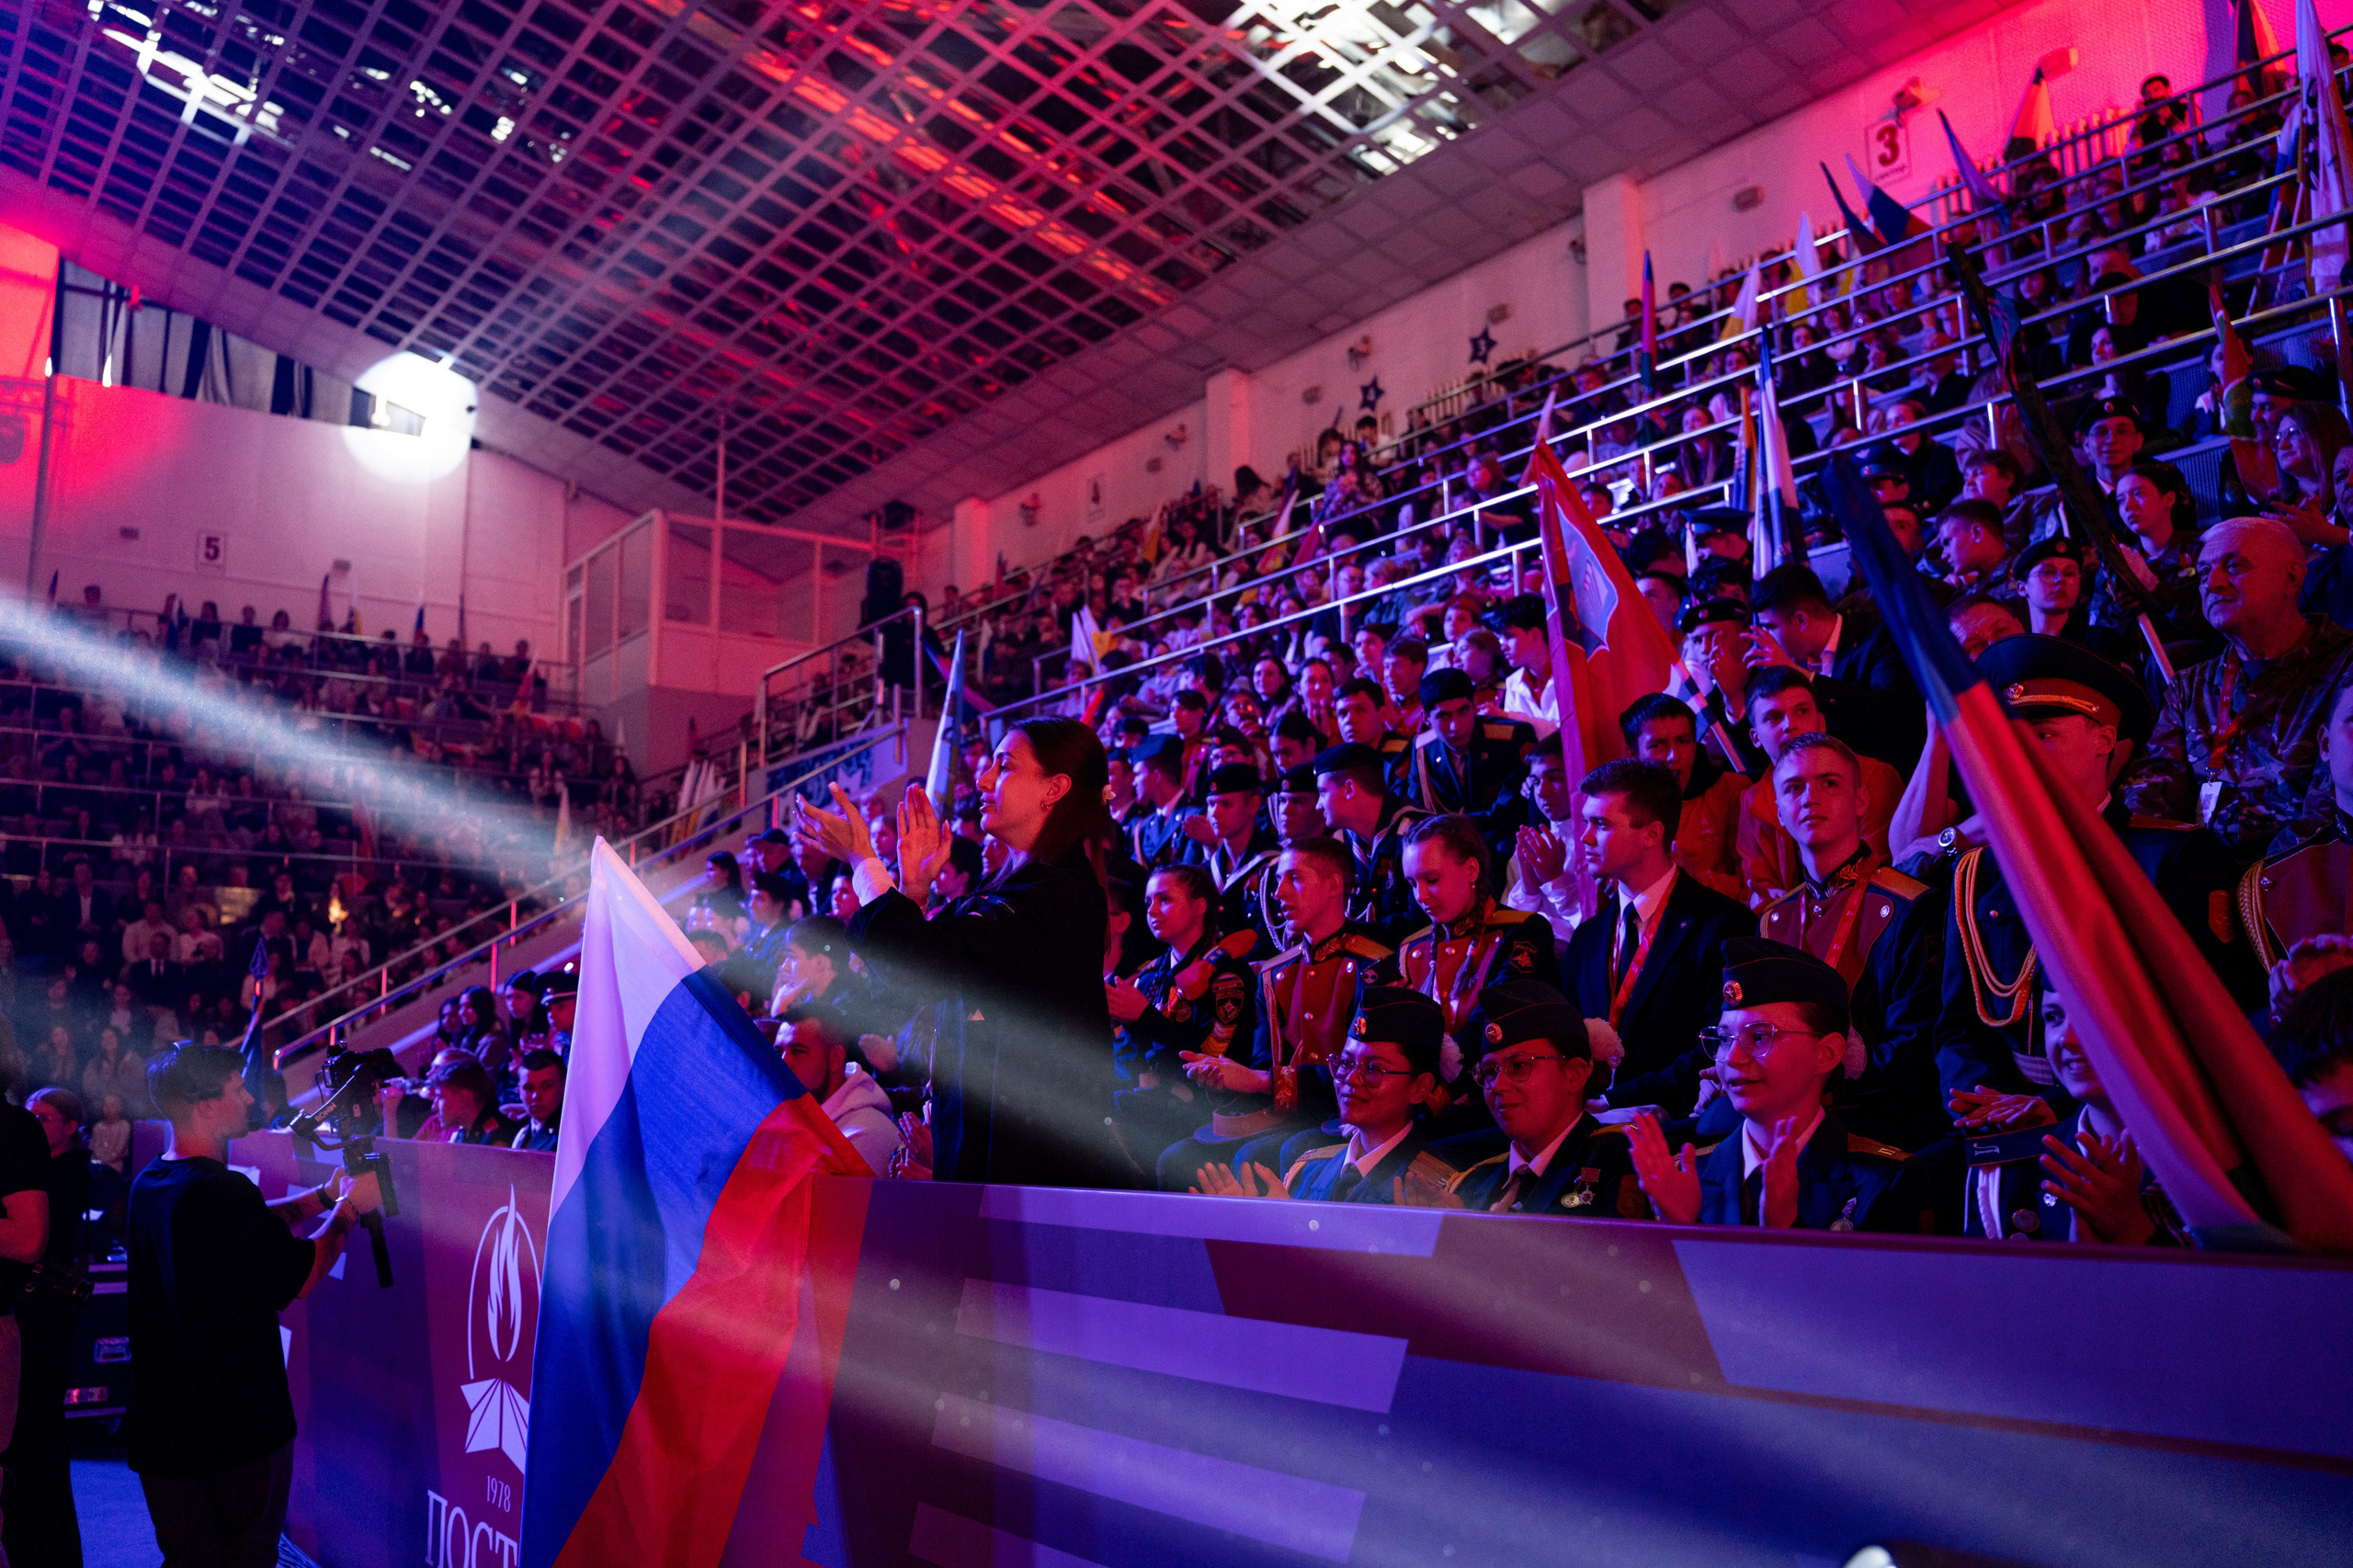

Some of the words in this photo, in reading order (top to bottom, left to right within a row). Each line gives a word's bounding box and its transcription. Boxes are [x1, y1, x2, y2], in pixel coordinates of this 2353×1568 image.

[1877, 124, 1900, 166] 3
[205, 537, 220, 560] 5
[313, 1102, 337, 1122] RONIN
[486, 1475, 511, 1513] 1978
